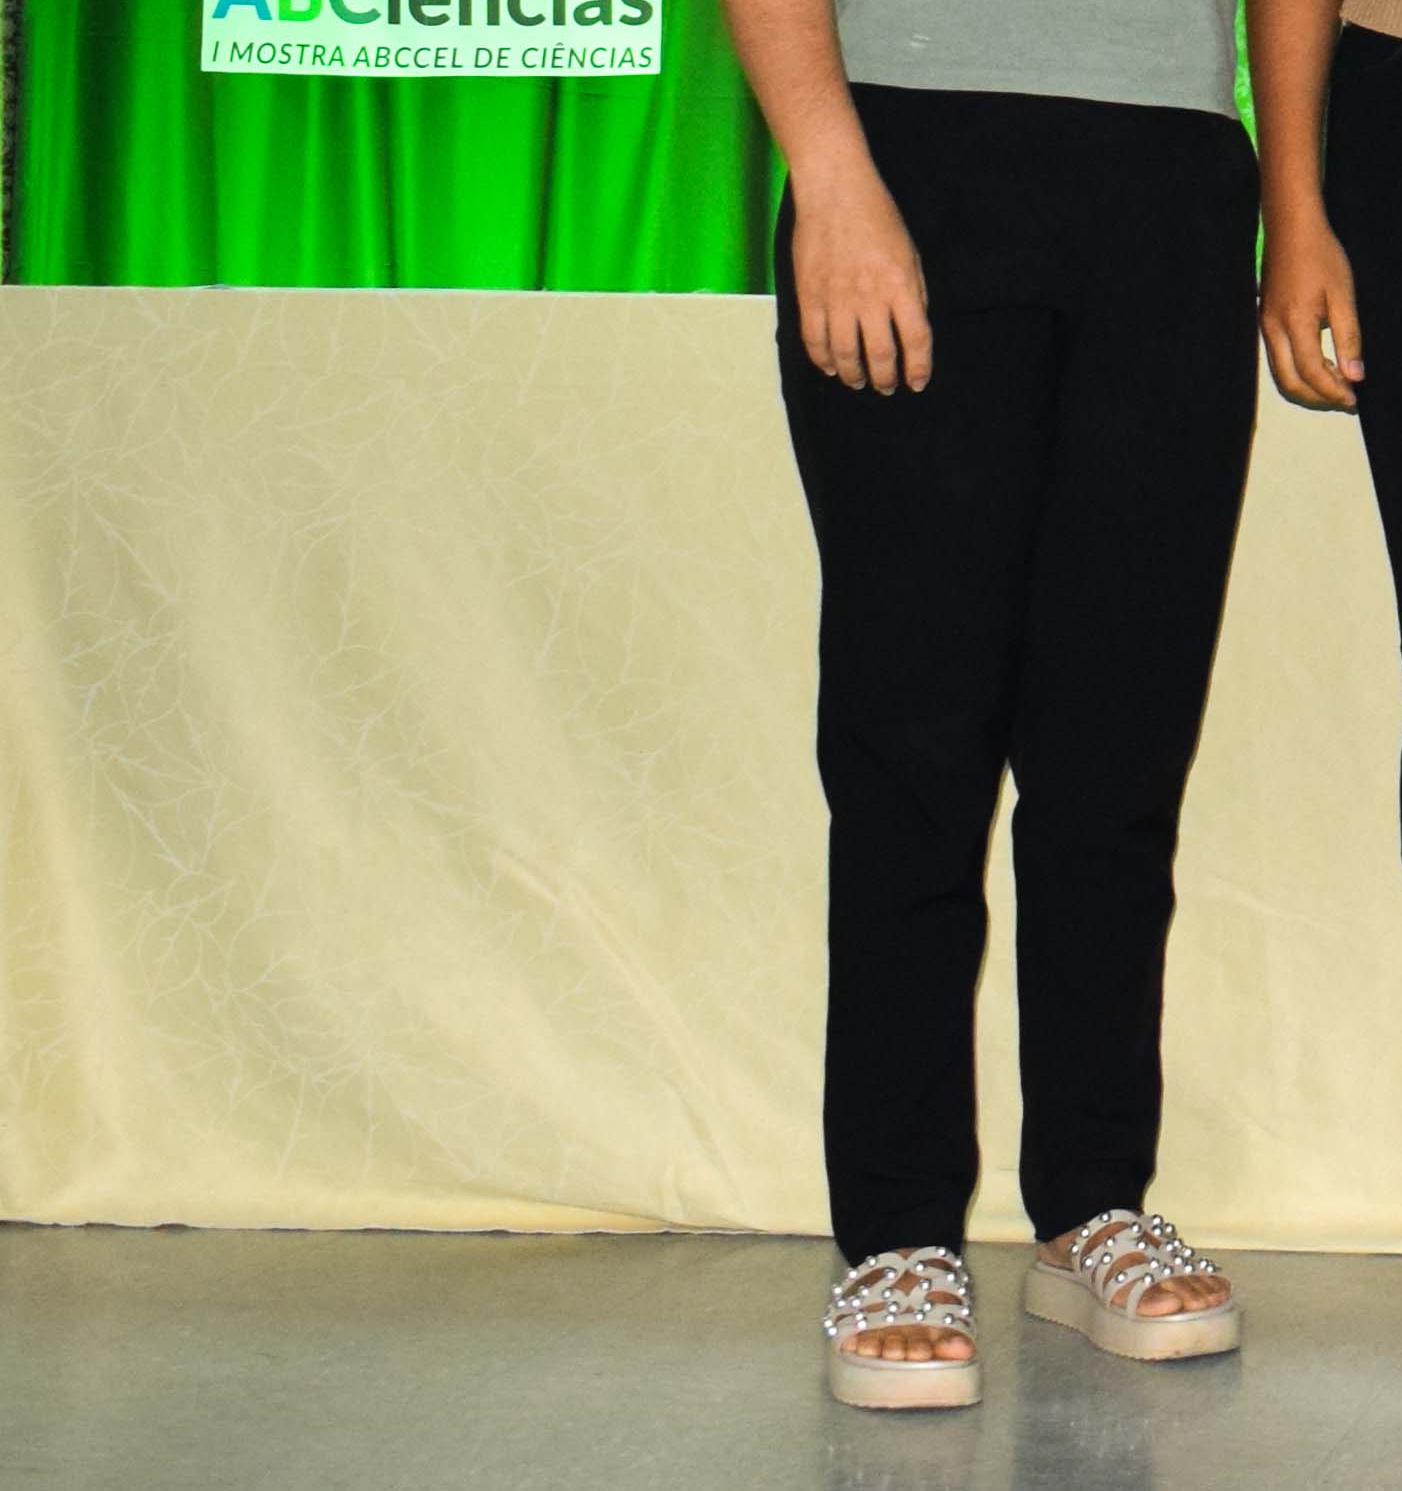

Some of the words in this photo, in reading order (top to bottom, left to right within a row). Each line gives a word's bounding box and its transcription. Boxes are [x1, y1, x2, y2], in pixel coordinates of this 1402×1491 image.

[212, 40, 220, 63] I
[229, 41, 346, 68] MOSTRA
[353, 45, 463, 69] ABCCEL
[474, 46, 512, 69] DE
[521, 41, 653, 69] CIÊNCIAS
